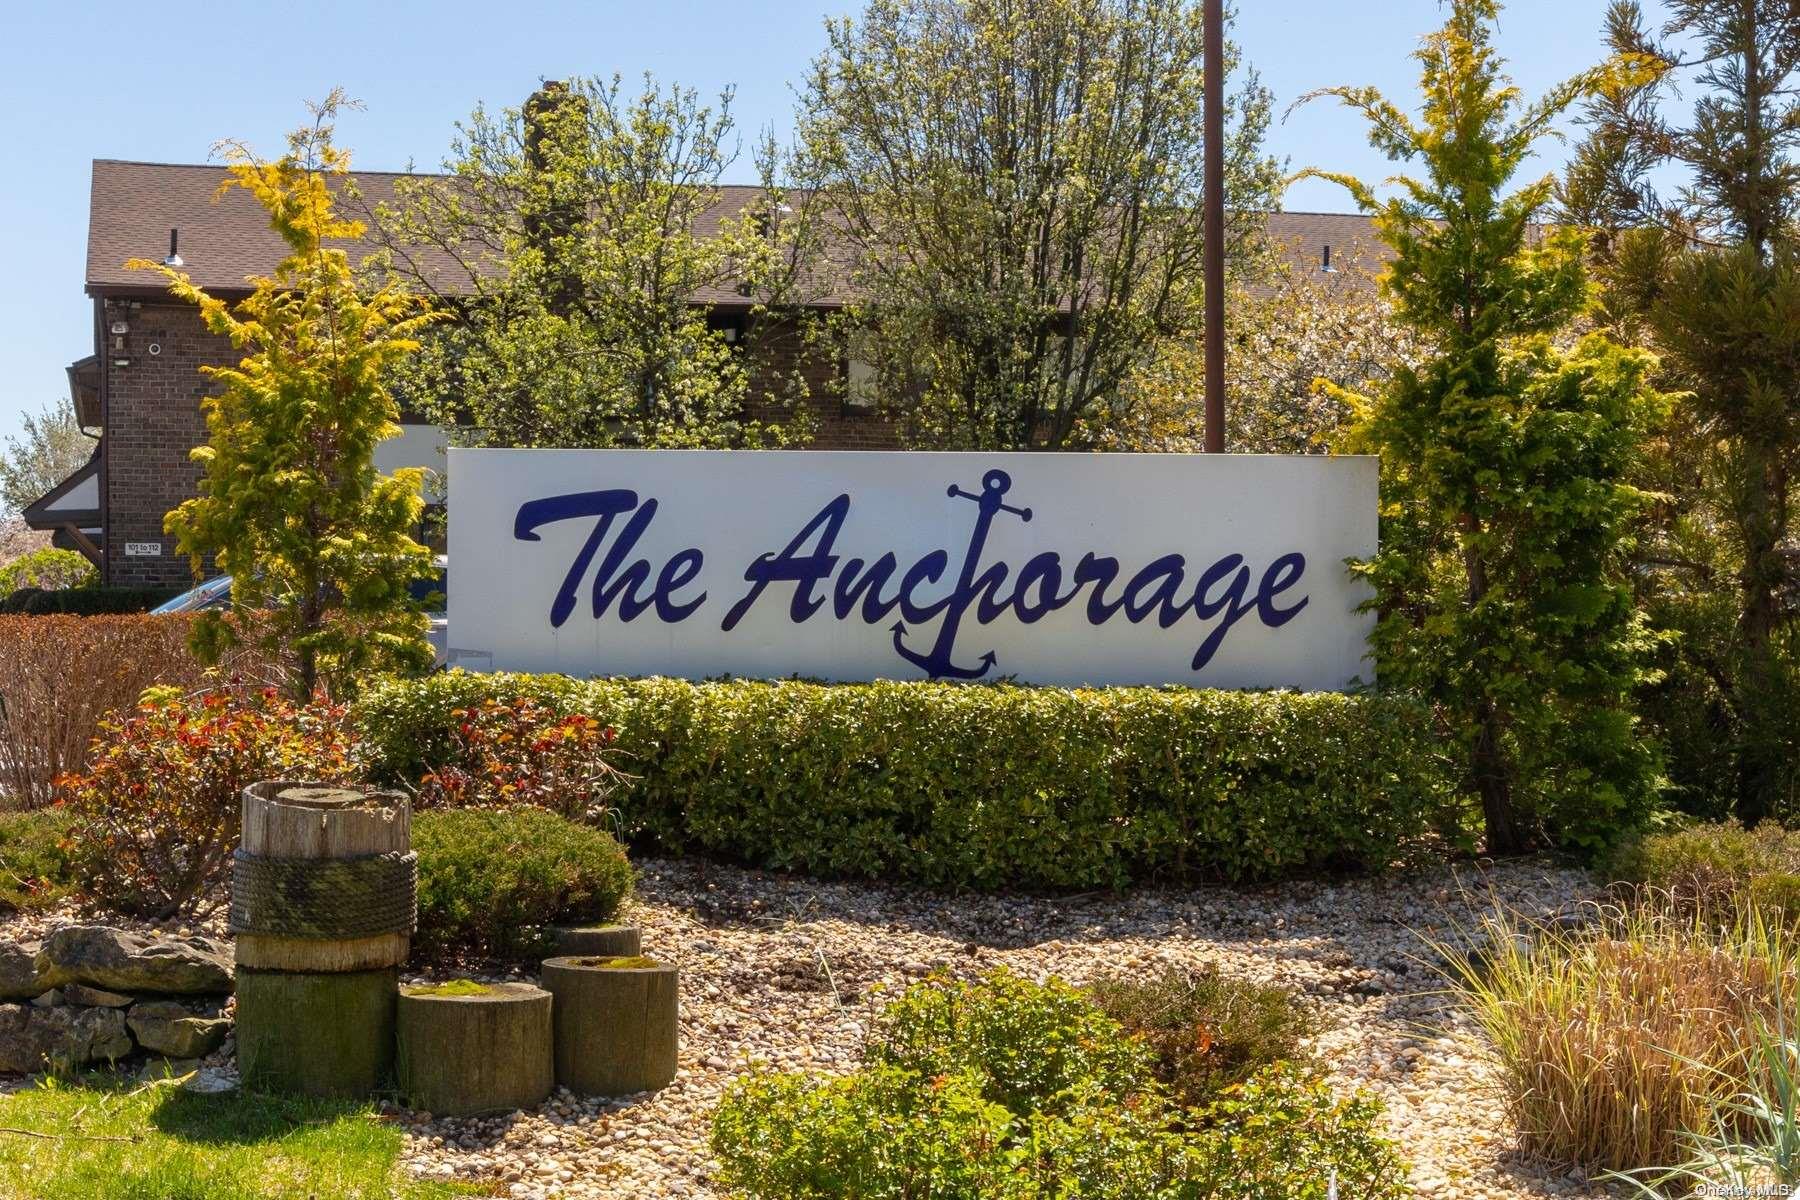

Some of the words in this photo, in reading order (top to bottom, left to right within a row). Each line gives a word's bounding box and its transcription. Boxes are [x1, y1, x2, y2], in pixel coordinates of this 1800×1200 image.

[128, 544, 138, 552] 101
[140, 544, 147, 552] to
[148, 544, 159, 552] 112
[514, 488, 708, 627] The
[721, 468, 1309, 679] Anchorage
